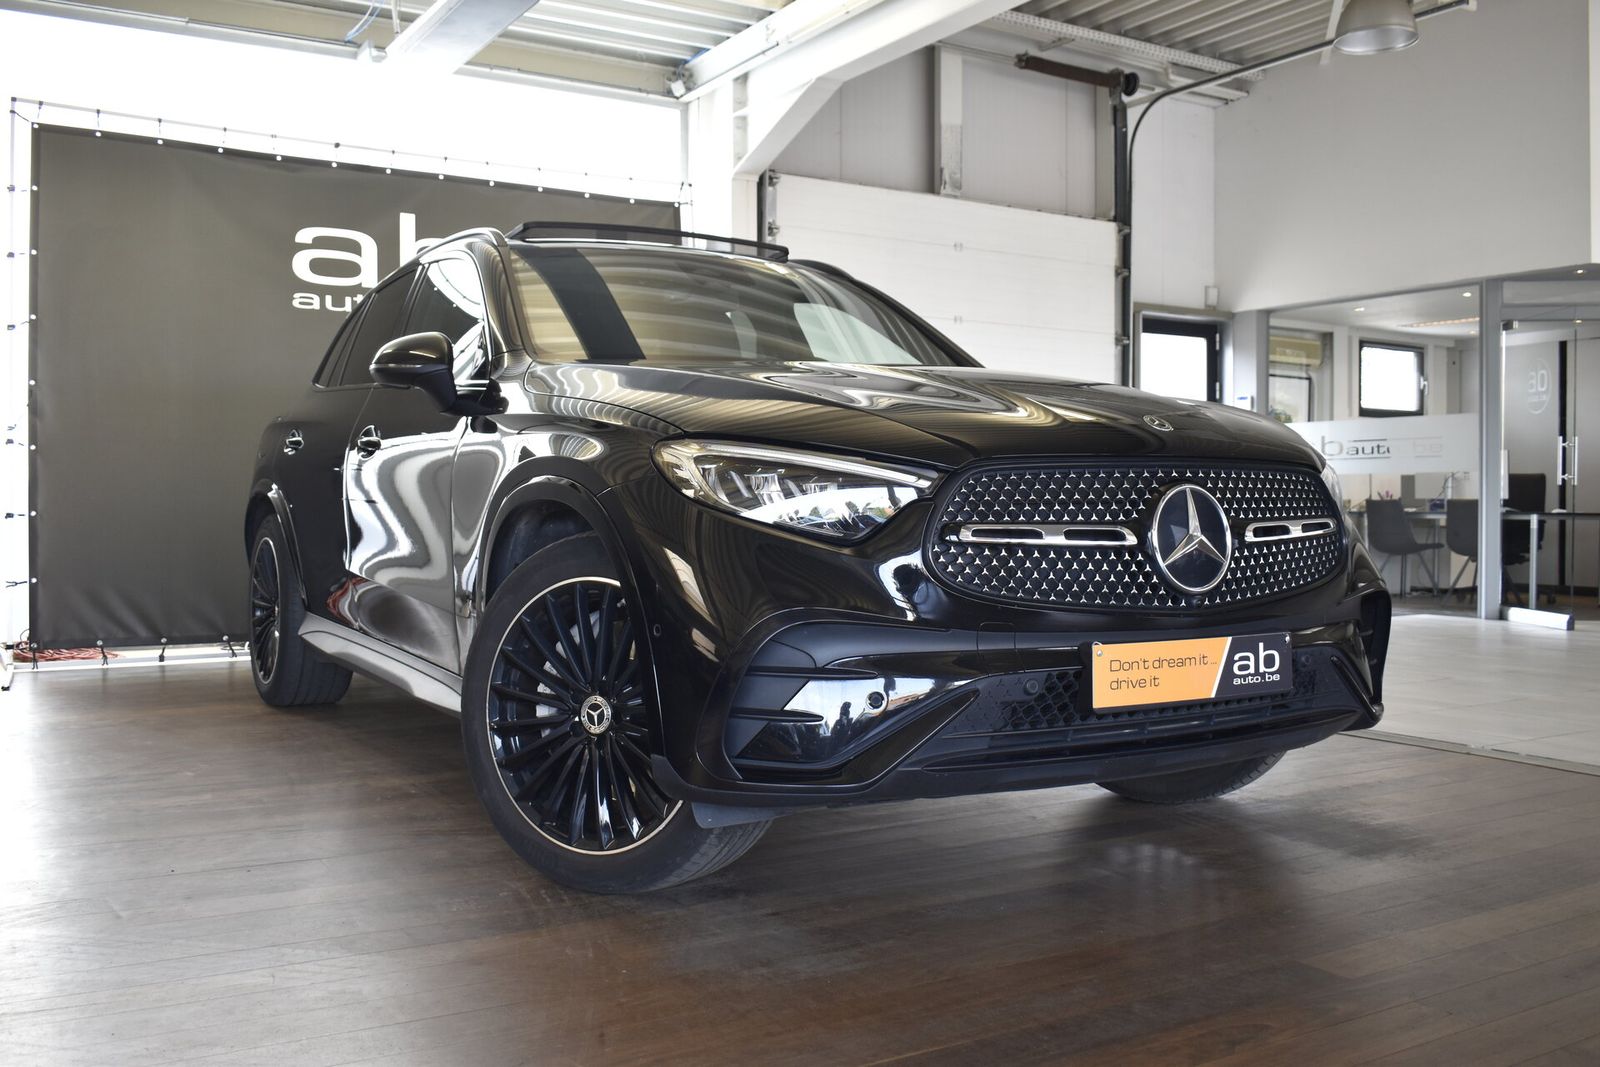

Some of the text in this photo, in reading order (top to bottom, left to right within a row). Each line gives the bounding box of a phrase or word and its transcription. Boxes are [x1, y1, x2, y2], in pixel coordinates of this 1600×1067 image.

[1109, 658, 1149, 672] Don't
[1152, 657, 1196, 669] dream
[1232, 642, 1280, 675] ab
[1109, 675, 1160, 690] drive it
[1232, 673, 1280, 685] auto.be
